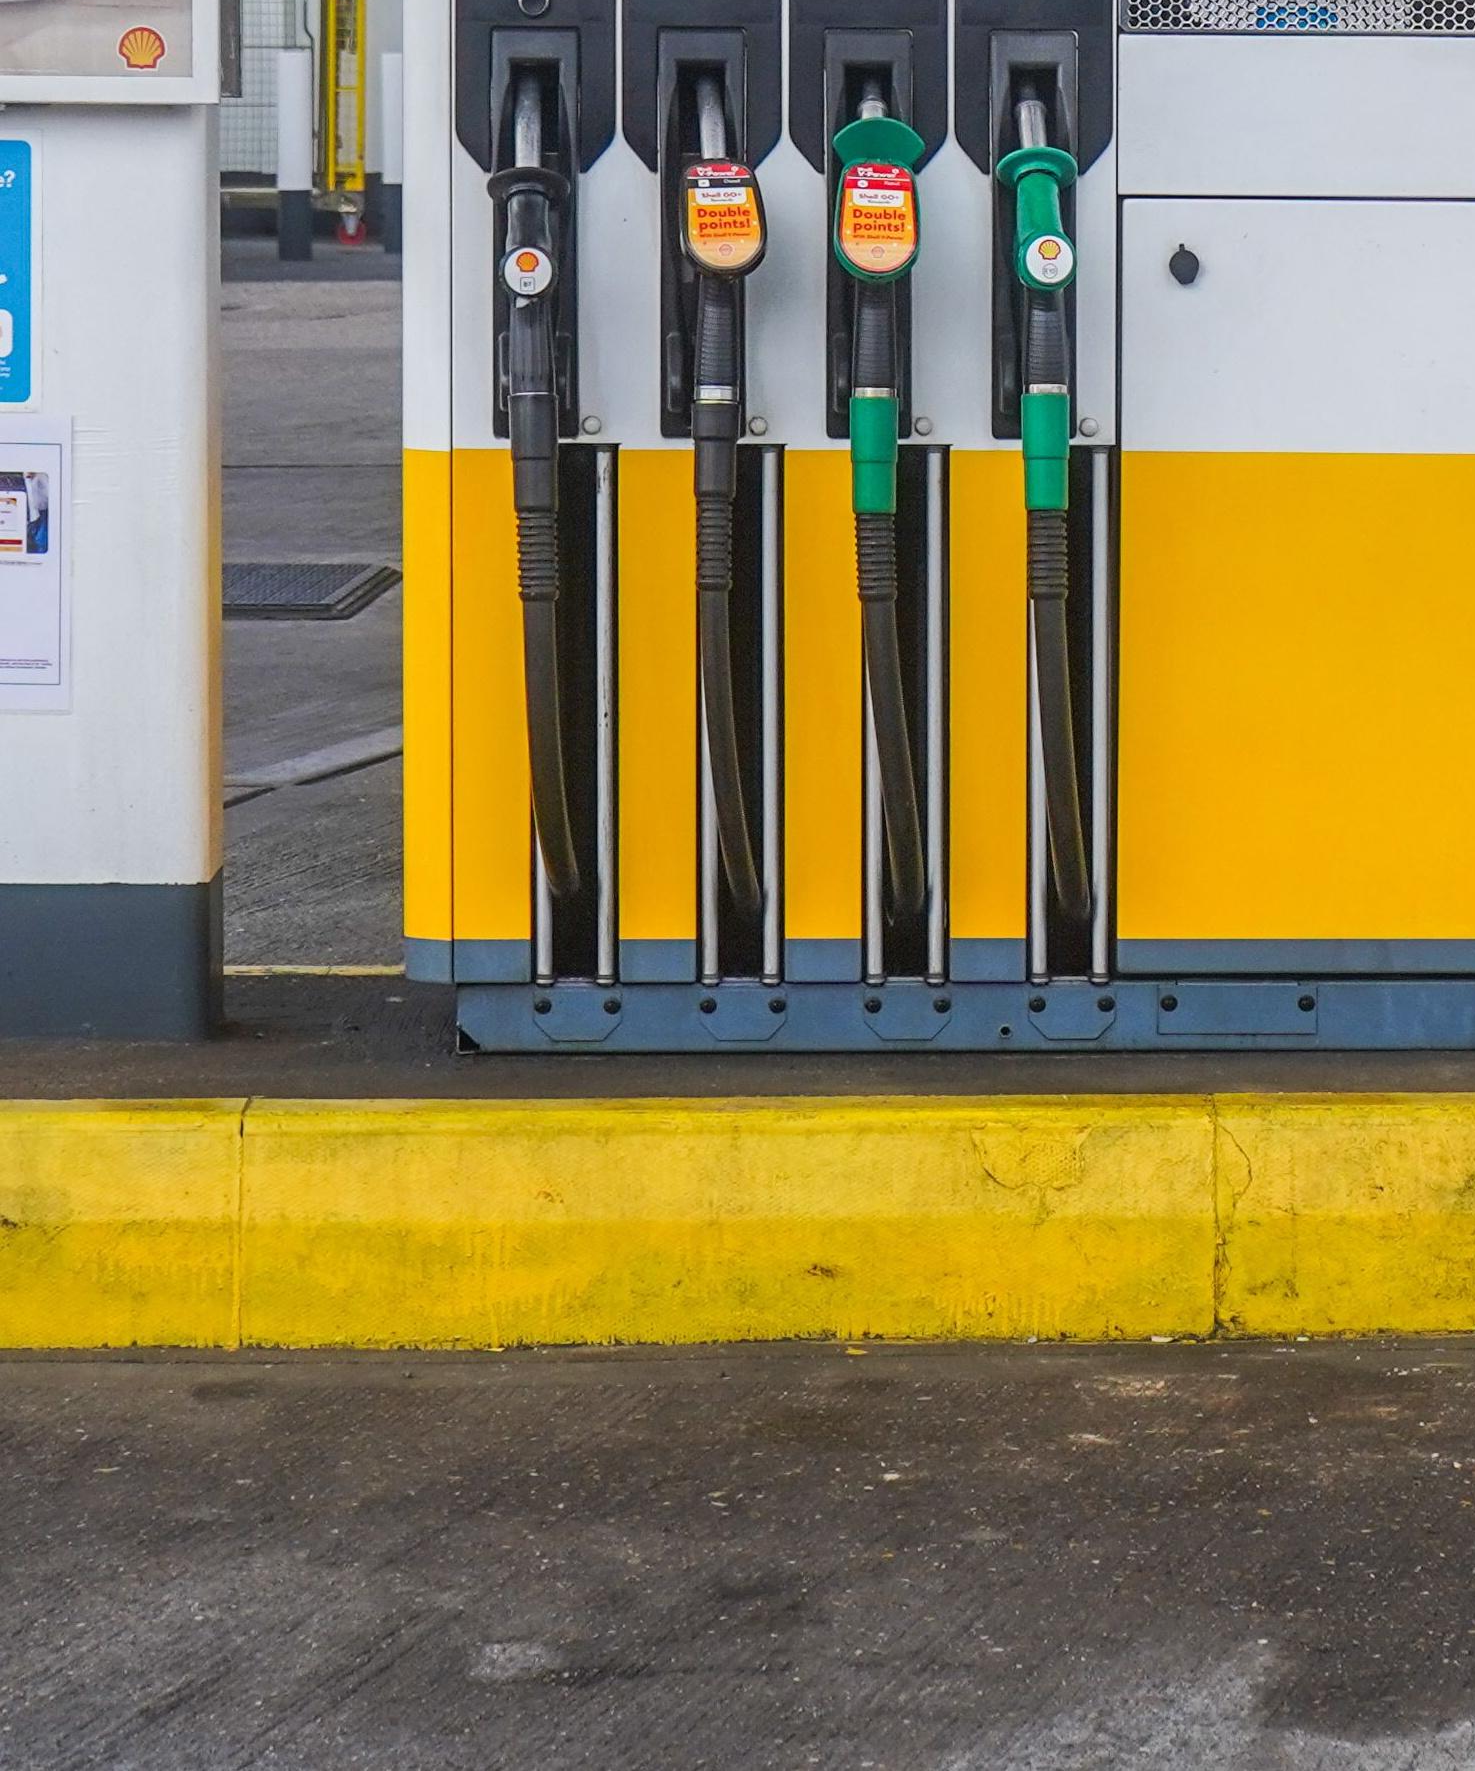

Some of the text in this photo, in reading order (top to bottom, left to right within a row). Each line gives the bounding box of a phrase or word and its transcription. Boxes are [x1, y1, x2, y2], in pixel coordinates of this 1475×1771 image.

[697, 206, 751, 218] Double
[853, 209, 906, 220] Double
[699, 218, 750, 232] points!
[854, 220, 904, 233] points!
